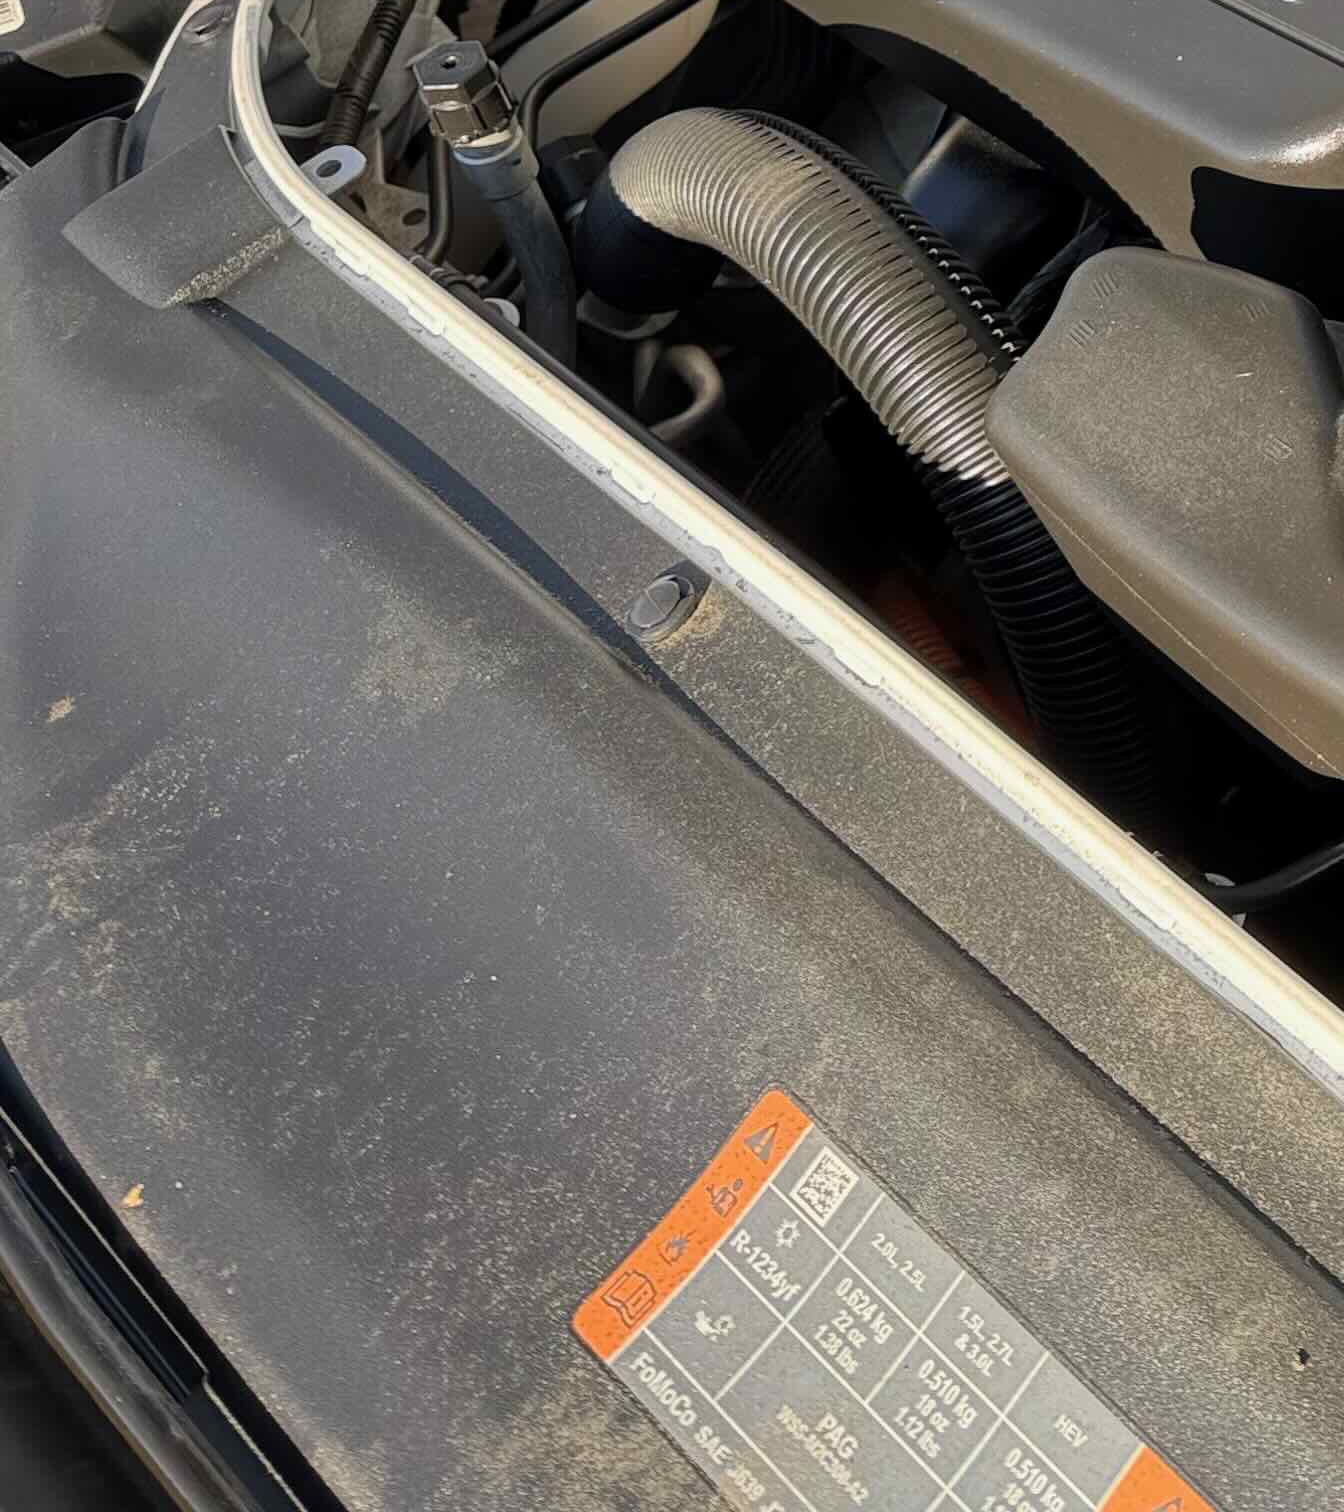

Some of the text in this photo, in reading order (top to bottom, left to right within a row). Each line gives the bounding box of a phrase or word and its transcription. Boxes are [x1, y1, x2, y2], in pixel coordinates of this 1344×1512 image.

[729, 1228, 802, 1301] R-1234yf
[899, 1260, 927, 1293] 2.5L
[831, 1309, 867, 1349] 22 oz
[835, 1277, 894, 1345] 0.624 kg
[813, 1324, 859, 1375] 1.38 lbs
[965, 1343, 995, 1377] 3.0L
[986, 1333, 1014, 1367] 2.7L
[628, 1351, 697, 1427] FoMoCo
[693, 1425, 733, 1465] SAE
[915, 1394, 951, 1433] 18 oz
[917, 1359, 979, 1429] 0.510 kg
[815, 1412, 859, 1460] PAG
[893, 1406, 941, 1459] 1.12 lbs
[1053, 1414, 1089, 1447] HEV
[1002, 1483, 1025, 1506] 18
[1004, 1447, 1049, 1495] 0.510
